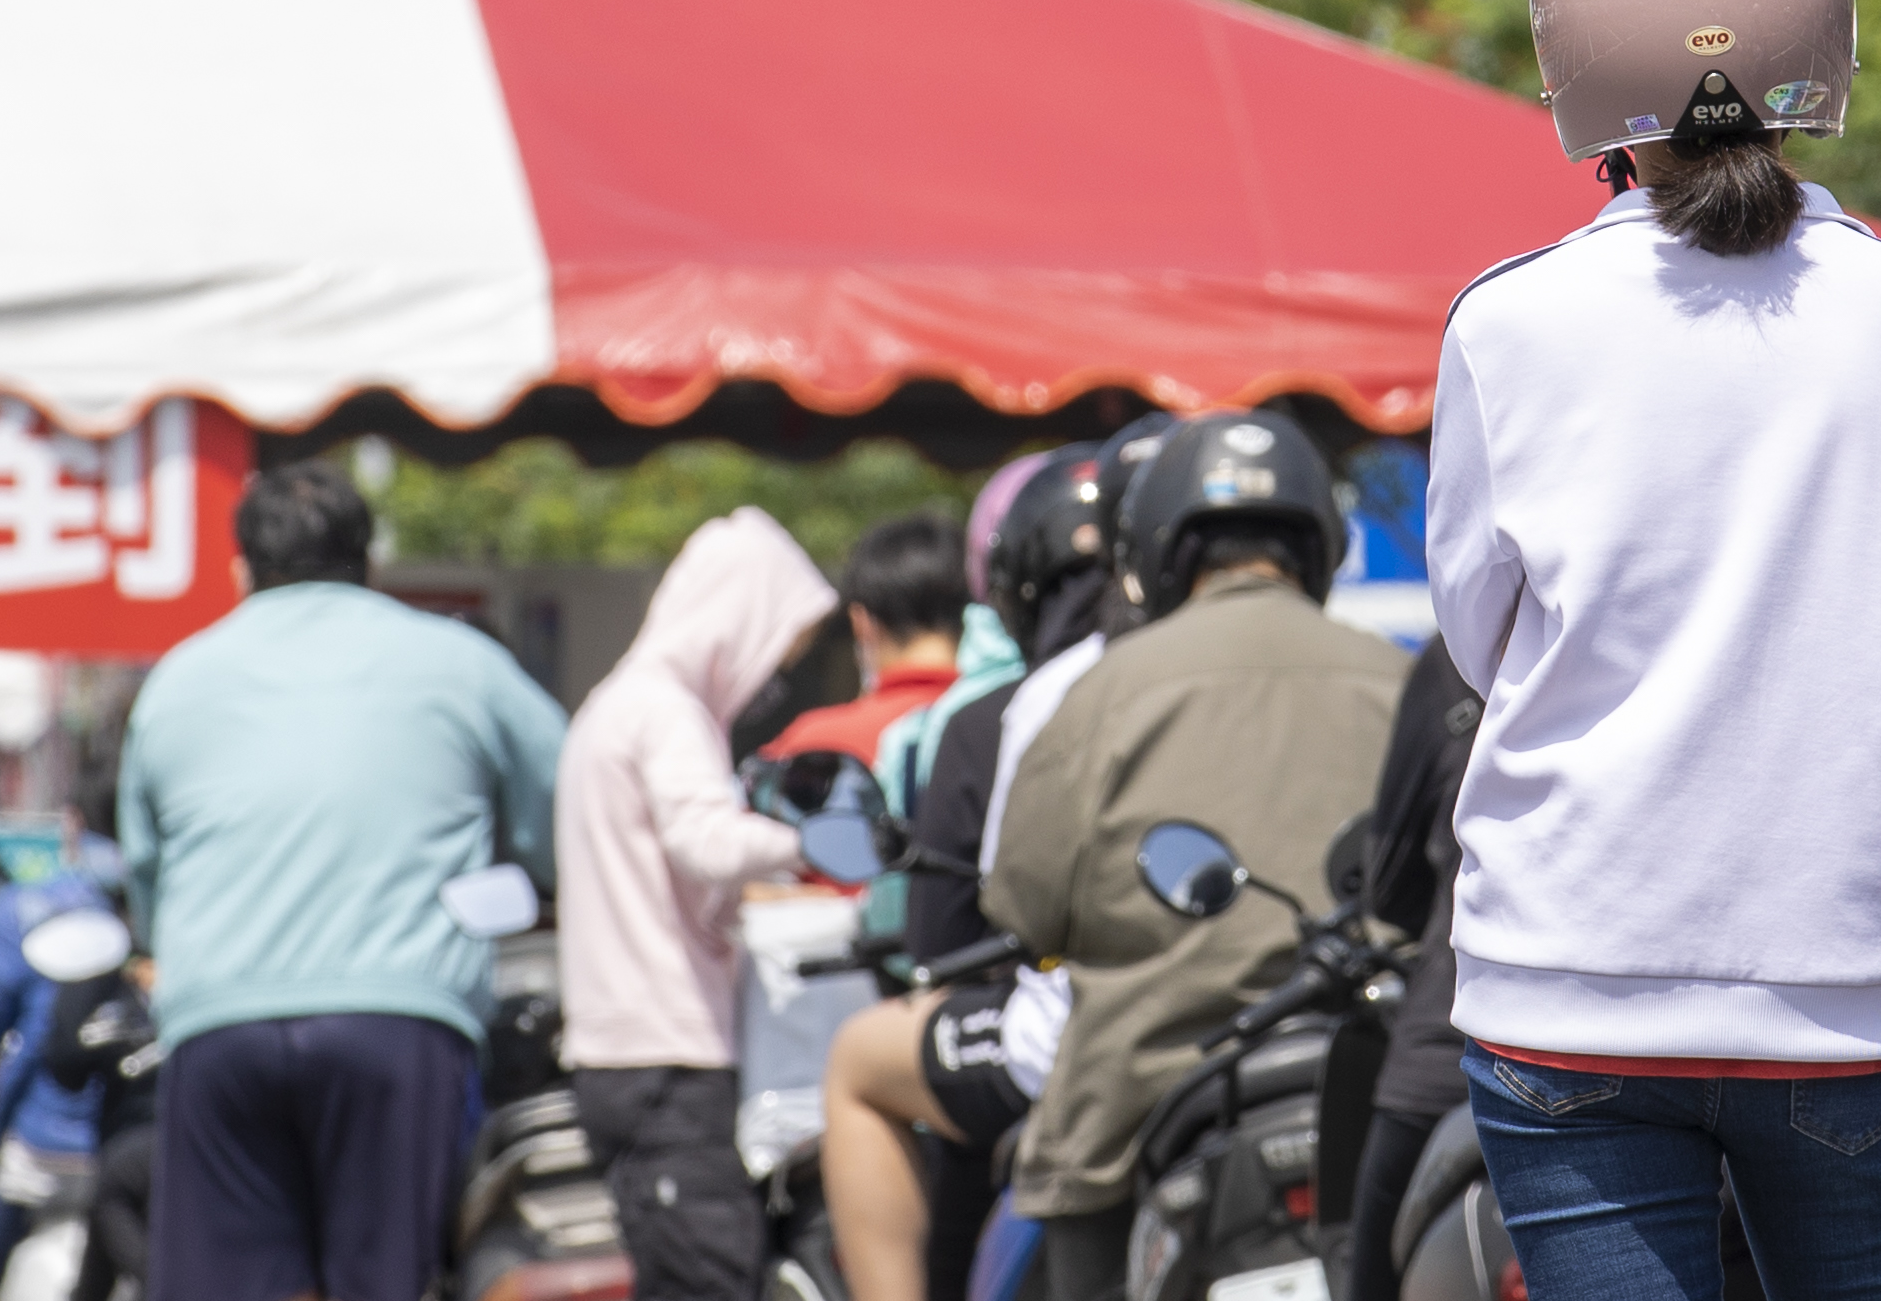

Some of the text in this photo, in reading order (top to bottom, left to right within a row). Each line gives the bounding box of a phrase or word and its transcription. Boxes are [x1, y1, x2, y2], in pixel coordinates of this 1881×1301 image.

[1692, 32, 1730, 47] evo
[1692, 102, 1742, 119] evo
[1695, 117, 1740, 125] HELMET
